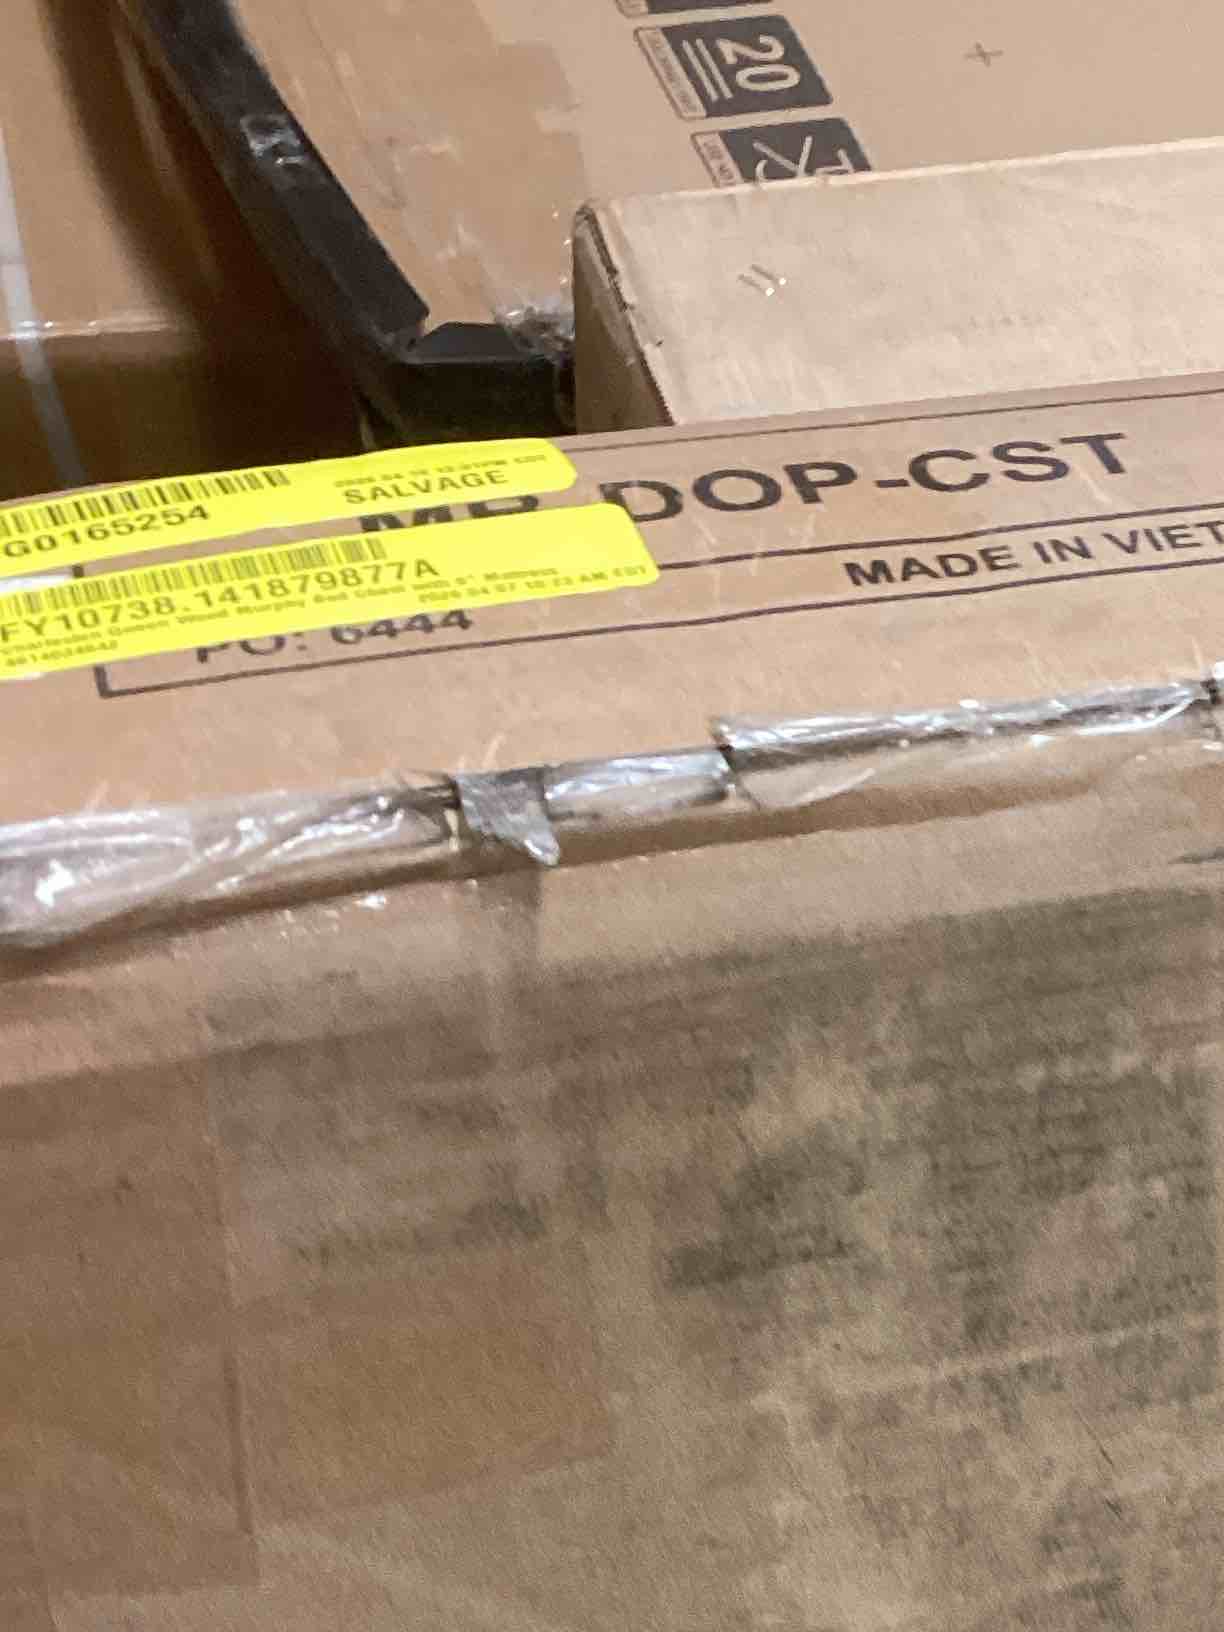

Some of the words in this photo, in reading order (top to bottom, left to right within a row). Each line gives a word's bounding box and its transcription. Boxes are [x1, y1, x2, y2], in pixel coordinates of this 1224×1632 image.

[713, 33, 801, 92] 20
[343, 469, 509, 505] SALVAGE
[598, 431, 1127, 523] DOP-CST
[4, 503, 211, 559] G0165254
[844, 544, 1023, 588] MADE
[1030, 534, 1095, 565] IN
